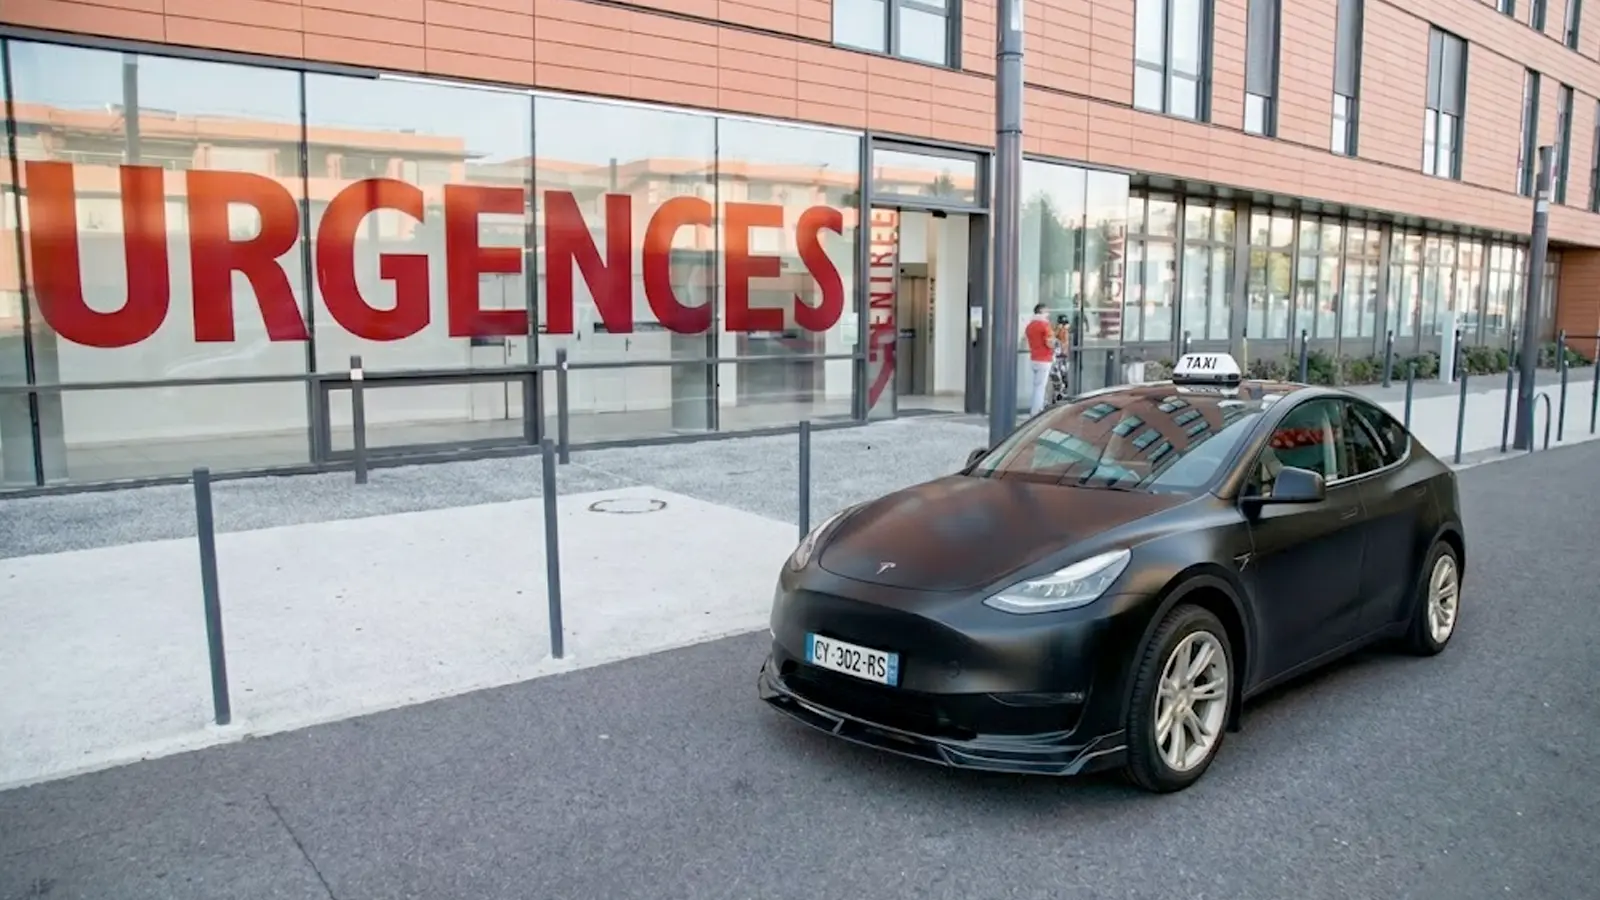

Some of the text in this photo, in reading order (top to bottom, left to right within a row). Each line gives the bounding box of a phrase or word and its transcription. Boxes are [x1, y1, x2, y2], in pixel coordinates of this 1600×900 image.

[25, 160, 844, 348] URGENCES
[1186, 356, 1217, 370] TAXI
[815, 640, 886, 678] CY-302-RS
